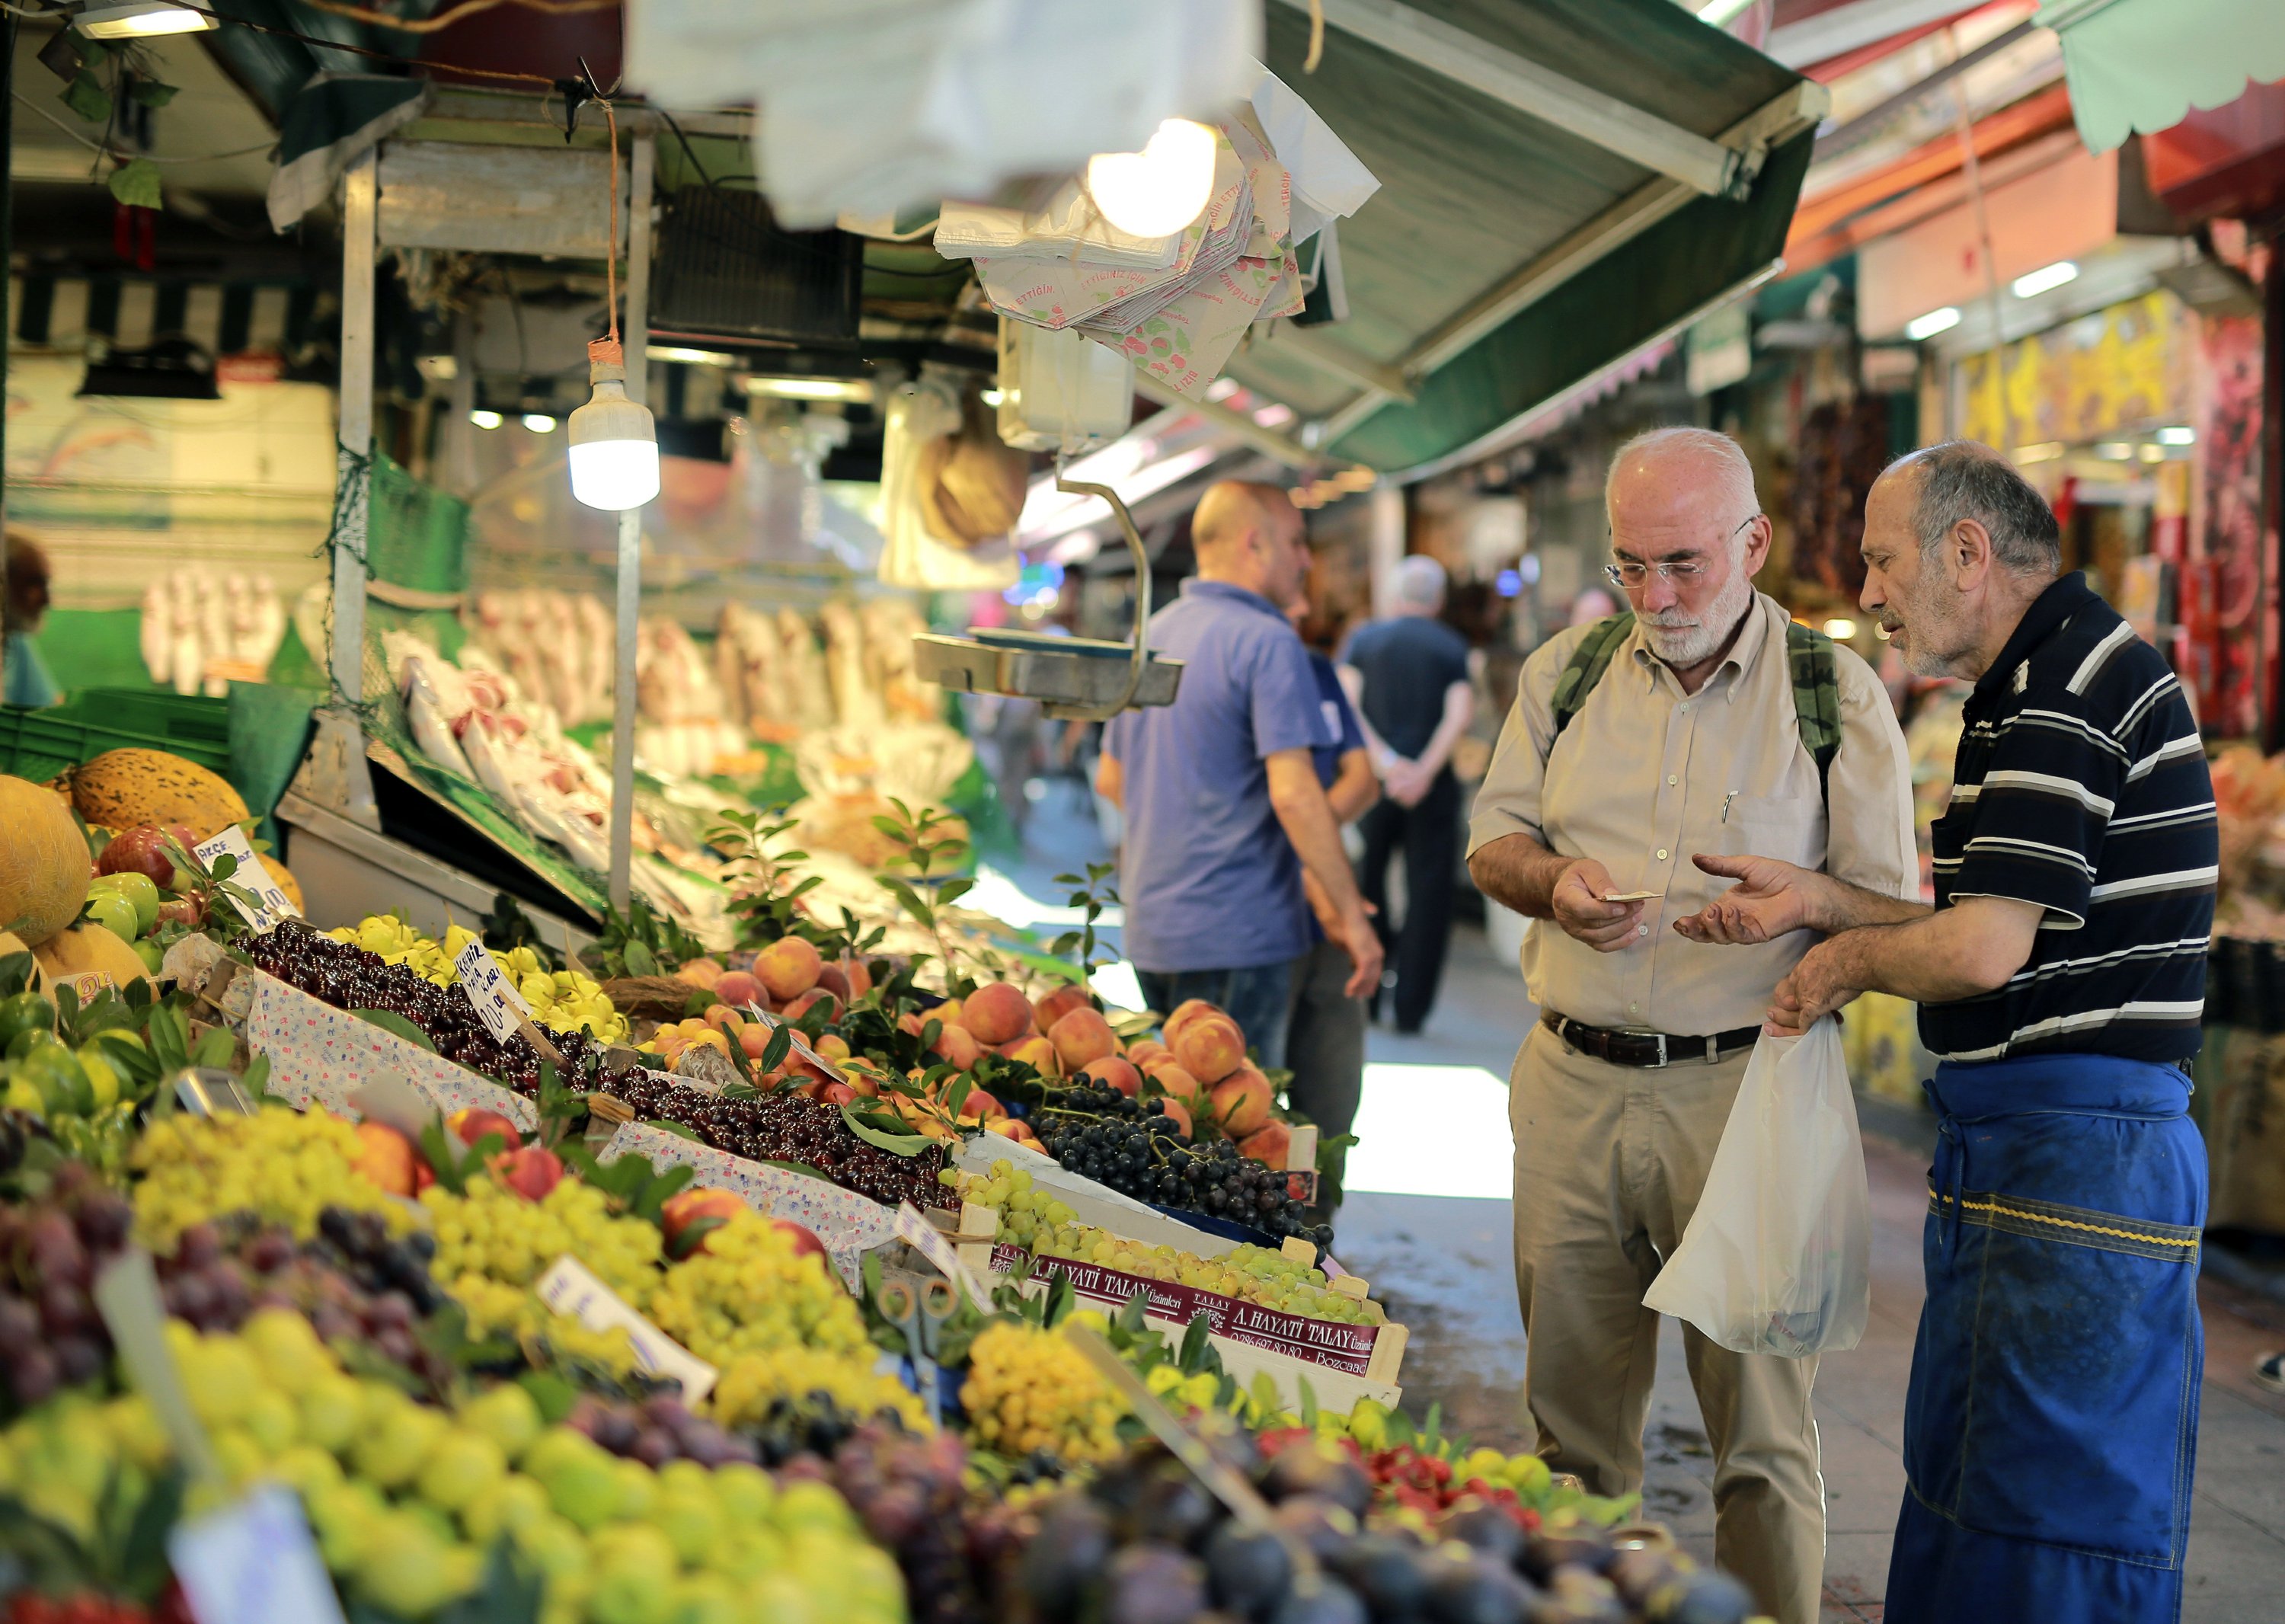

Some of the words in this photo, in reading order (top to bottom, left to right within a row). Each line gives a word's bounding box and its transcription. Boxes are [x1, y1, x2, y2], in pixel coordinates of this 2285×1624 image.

[1148, 1289, 1182, 1309] Üzümleri
[1194, 1293, 1231, 1309] TALAY
[1233, 1308, 1247, 1325] A.
[1249, 1311, 1304, 1338] HAYATİ
[1308, 1324, 1353, 1348] TALAY
